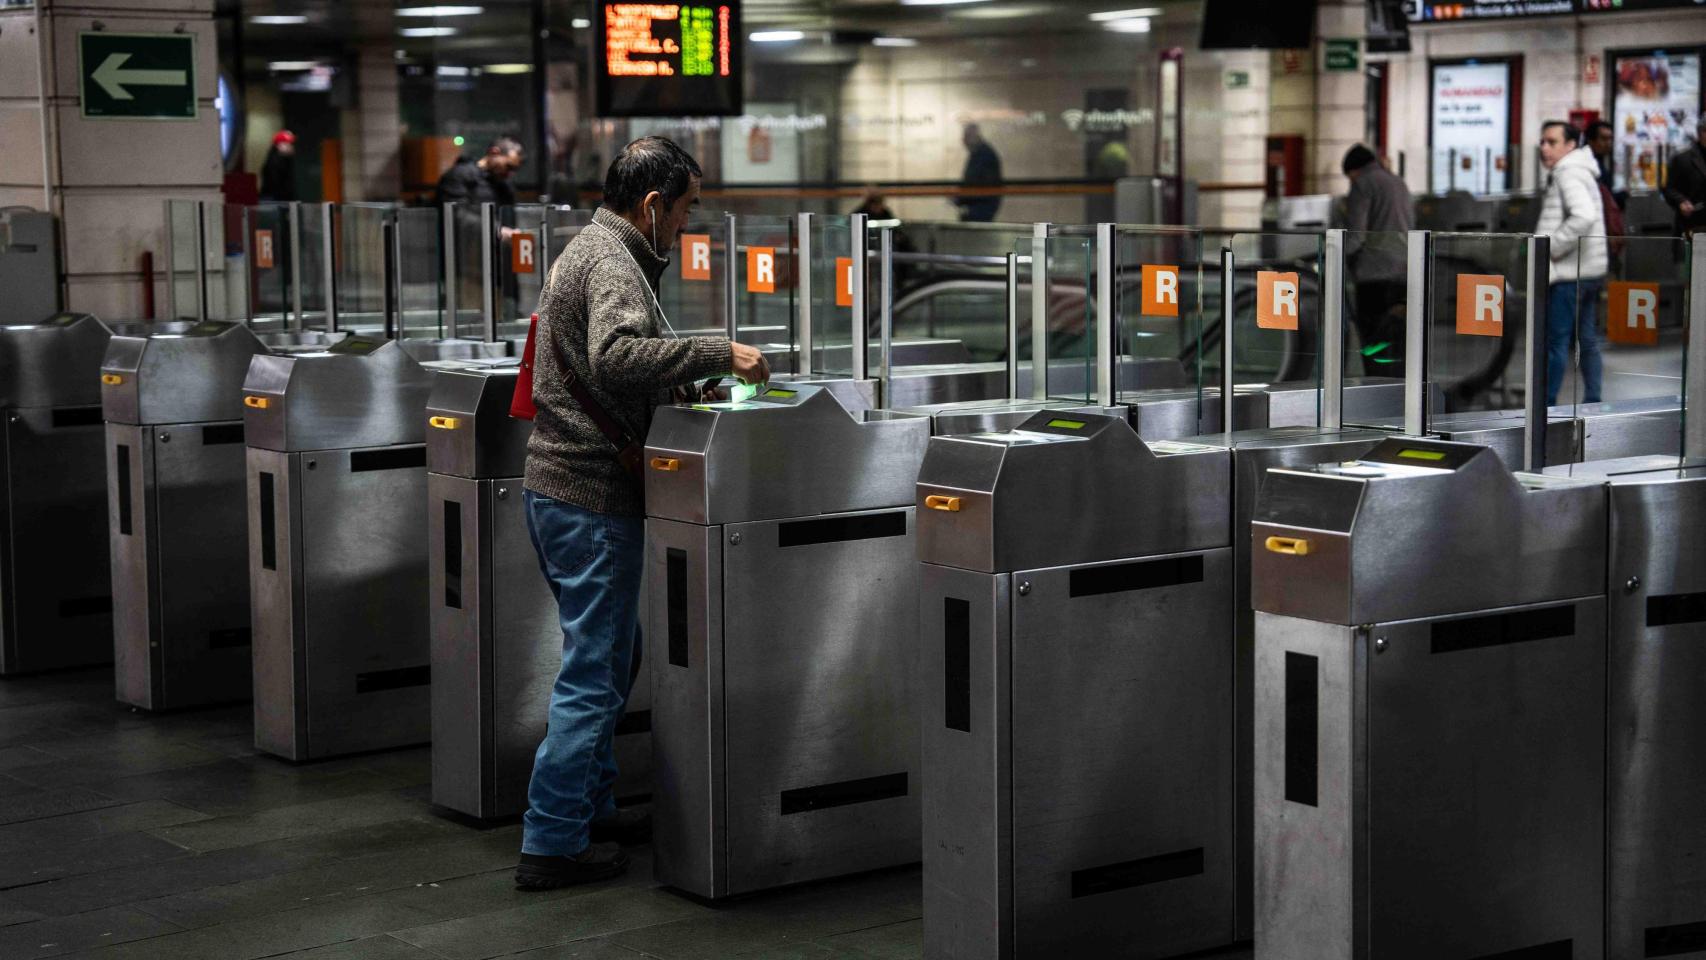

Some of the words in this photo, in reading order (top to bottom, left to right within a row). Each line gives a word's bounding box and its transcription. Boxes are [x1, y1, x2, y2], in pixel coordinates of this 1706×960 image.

[262, 236, 272, 259] R
[520, 240, 533, 264] R
[692, 242, 709, 270] R
[758, 254, 774, 282] R
[1157, 271, 1177, 303] R
[1273, 281, 1297, 316] R
[1475, 285, 1502, 321] R
[1627, 289, 1656, 328] R
